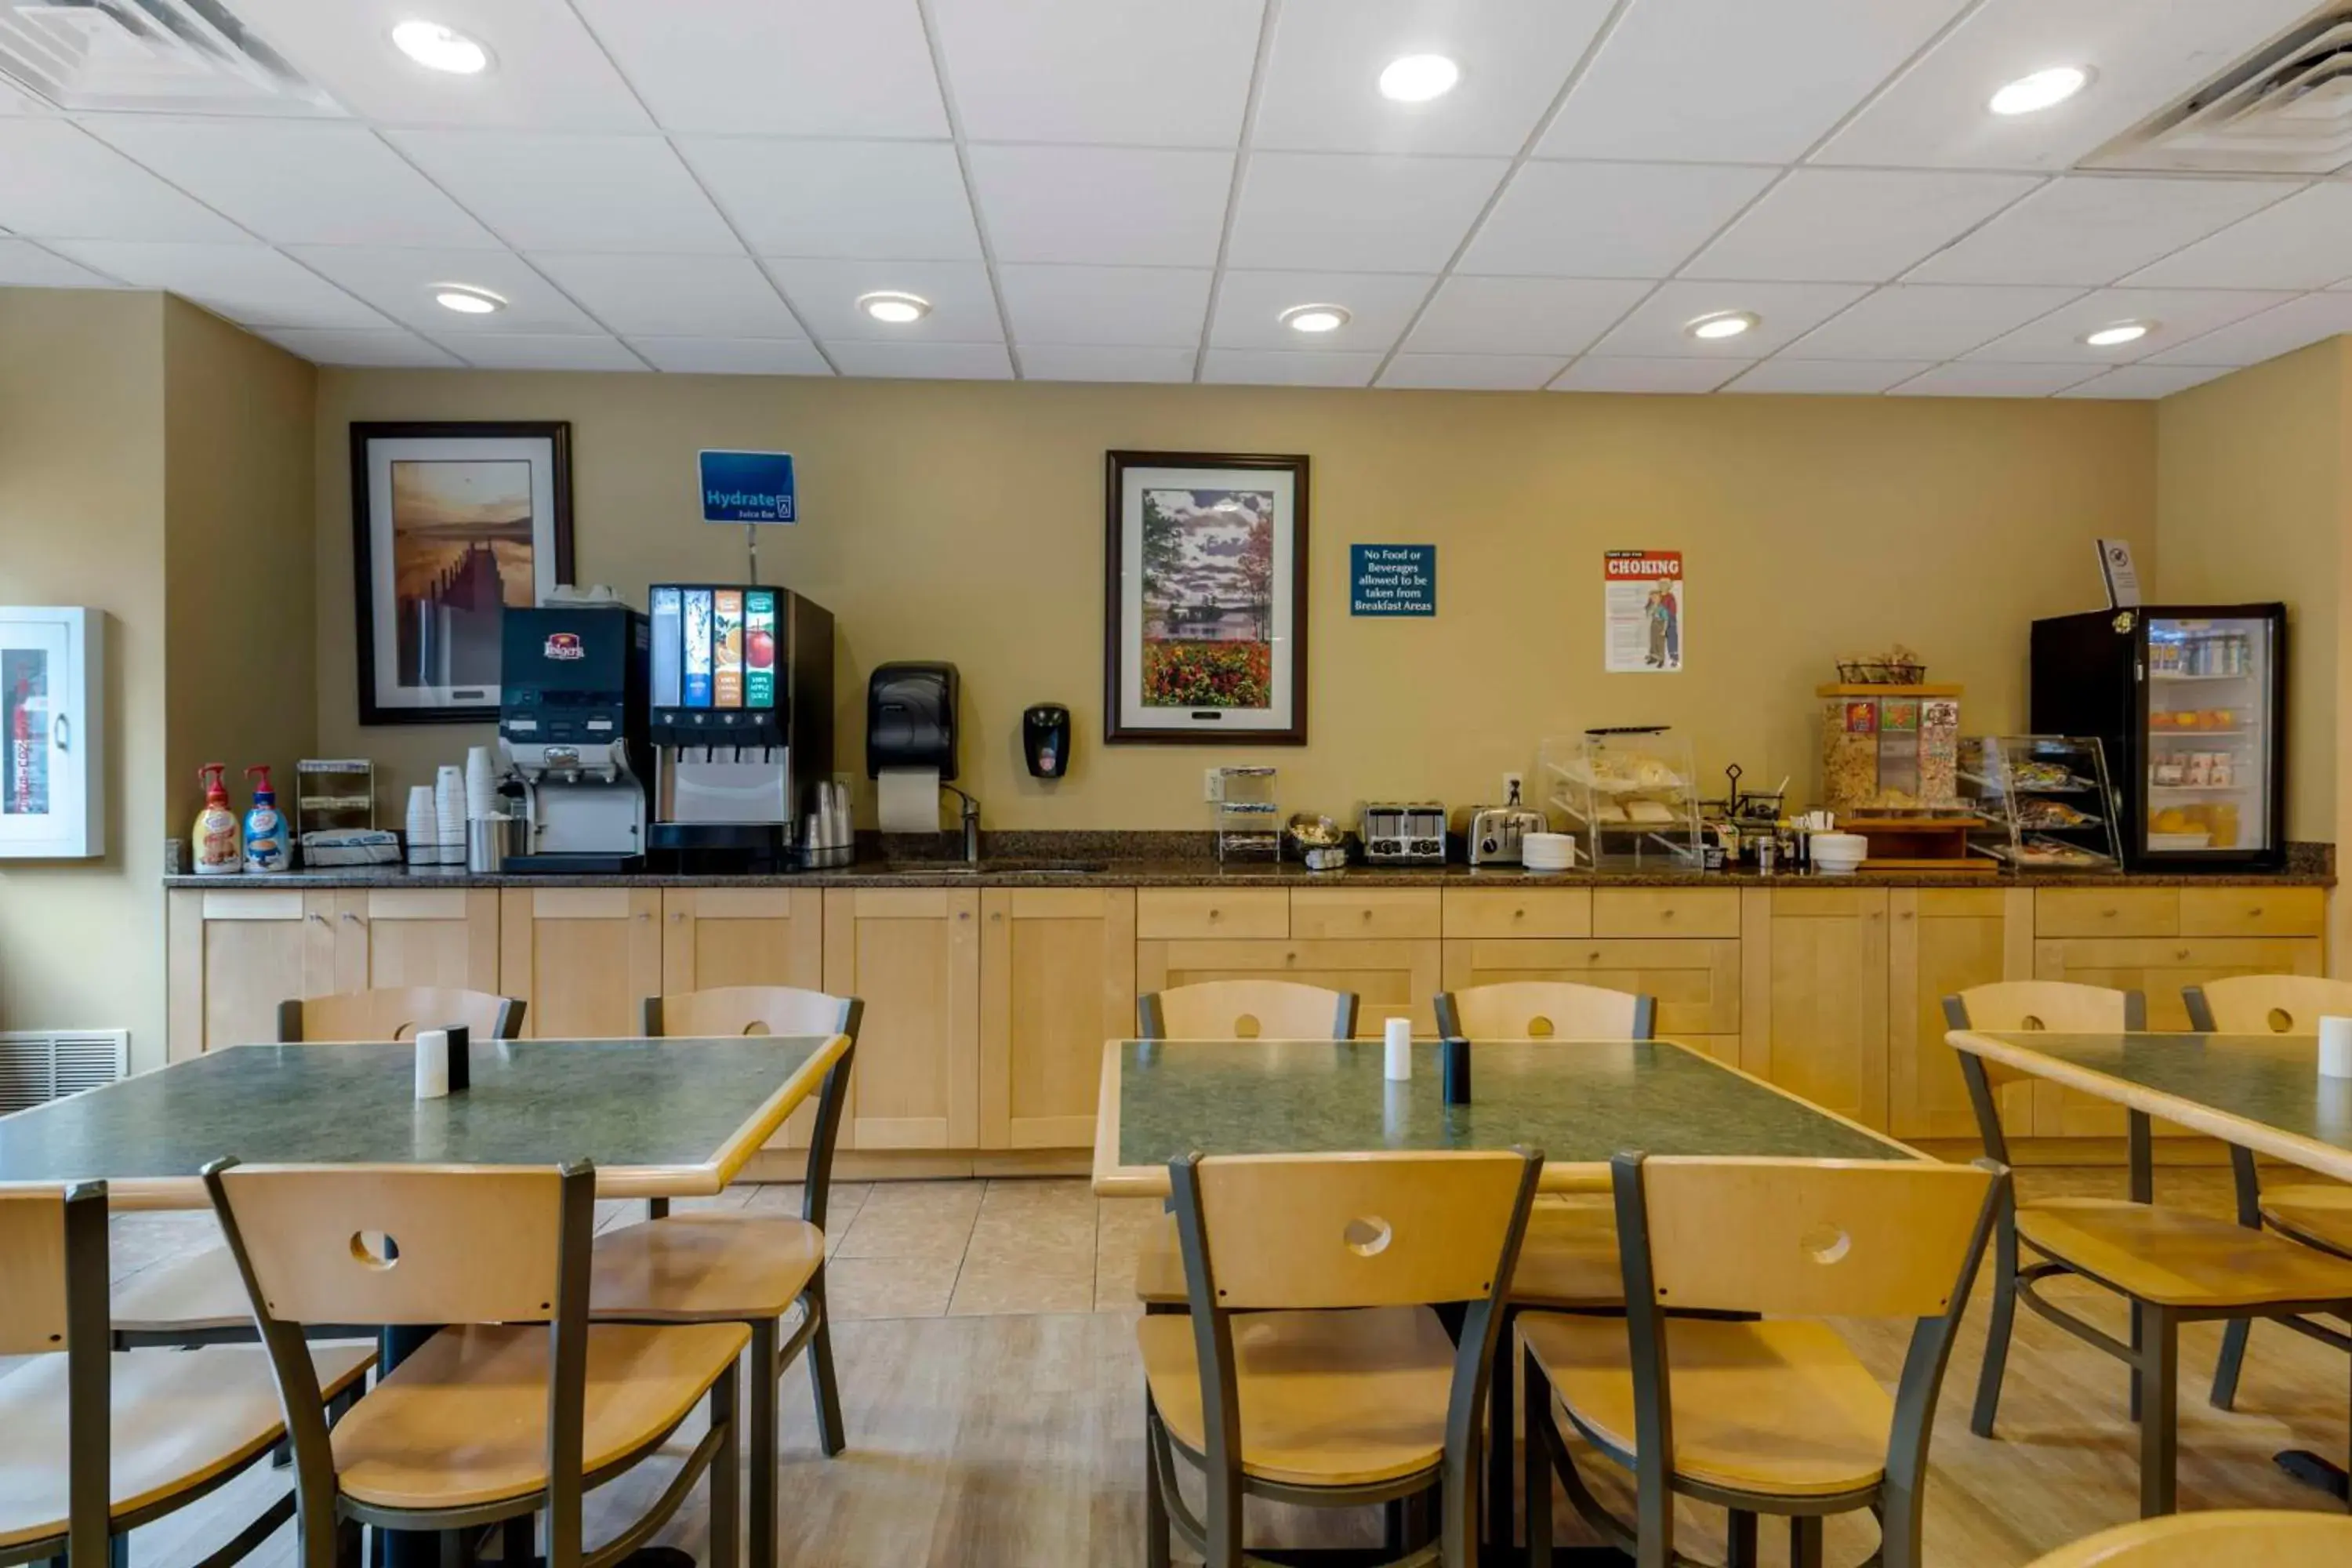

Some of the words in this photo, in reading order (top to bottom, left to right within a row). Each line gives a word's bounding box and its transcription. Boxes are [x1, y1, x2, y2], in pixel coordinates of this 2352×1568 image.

[706, 489, 775, 508] Hydrate
[1364, 550, 1380, 560] No
[1382, 549, 1408, 560] Food
[1368, 563, 1418, 575] Beverages
[1608, 560, 1679, 575] CHOKING
[1359, 575, 1399, 585] allowed
[1401, 576, 1412, 586] to
[1414, 575, 1428, 585] be
[1365, 587, 1394, 597] taken
[1396, 587, 1421, 597] from
[1355, 600, 1402, 611] Breakfast
[1403, 601, 1432, 611] Areas
